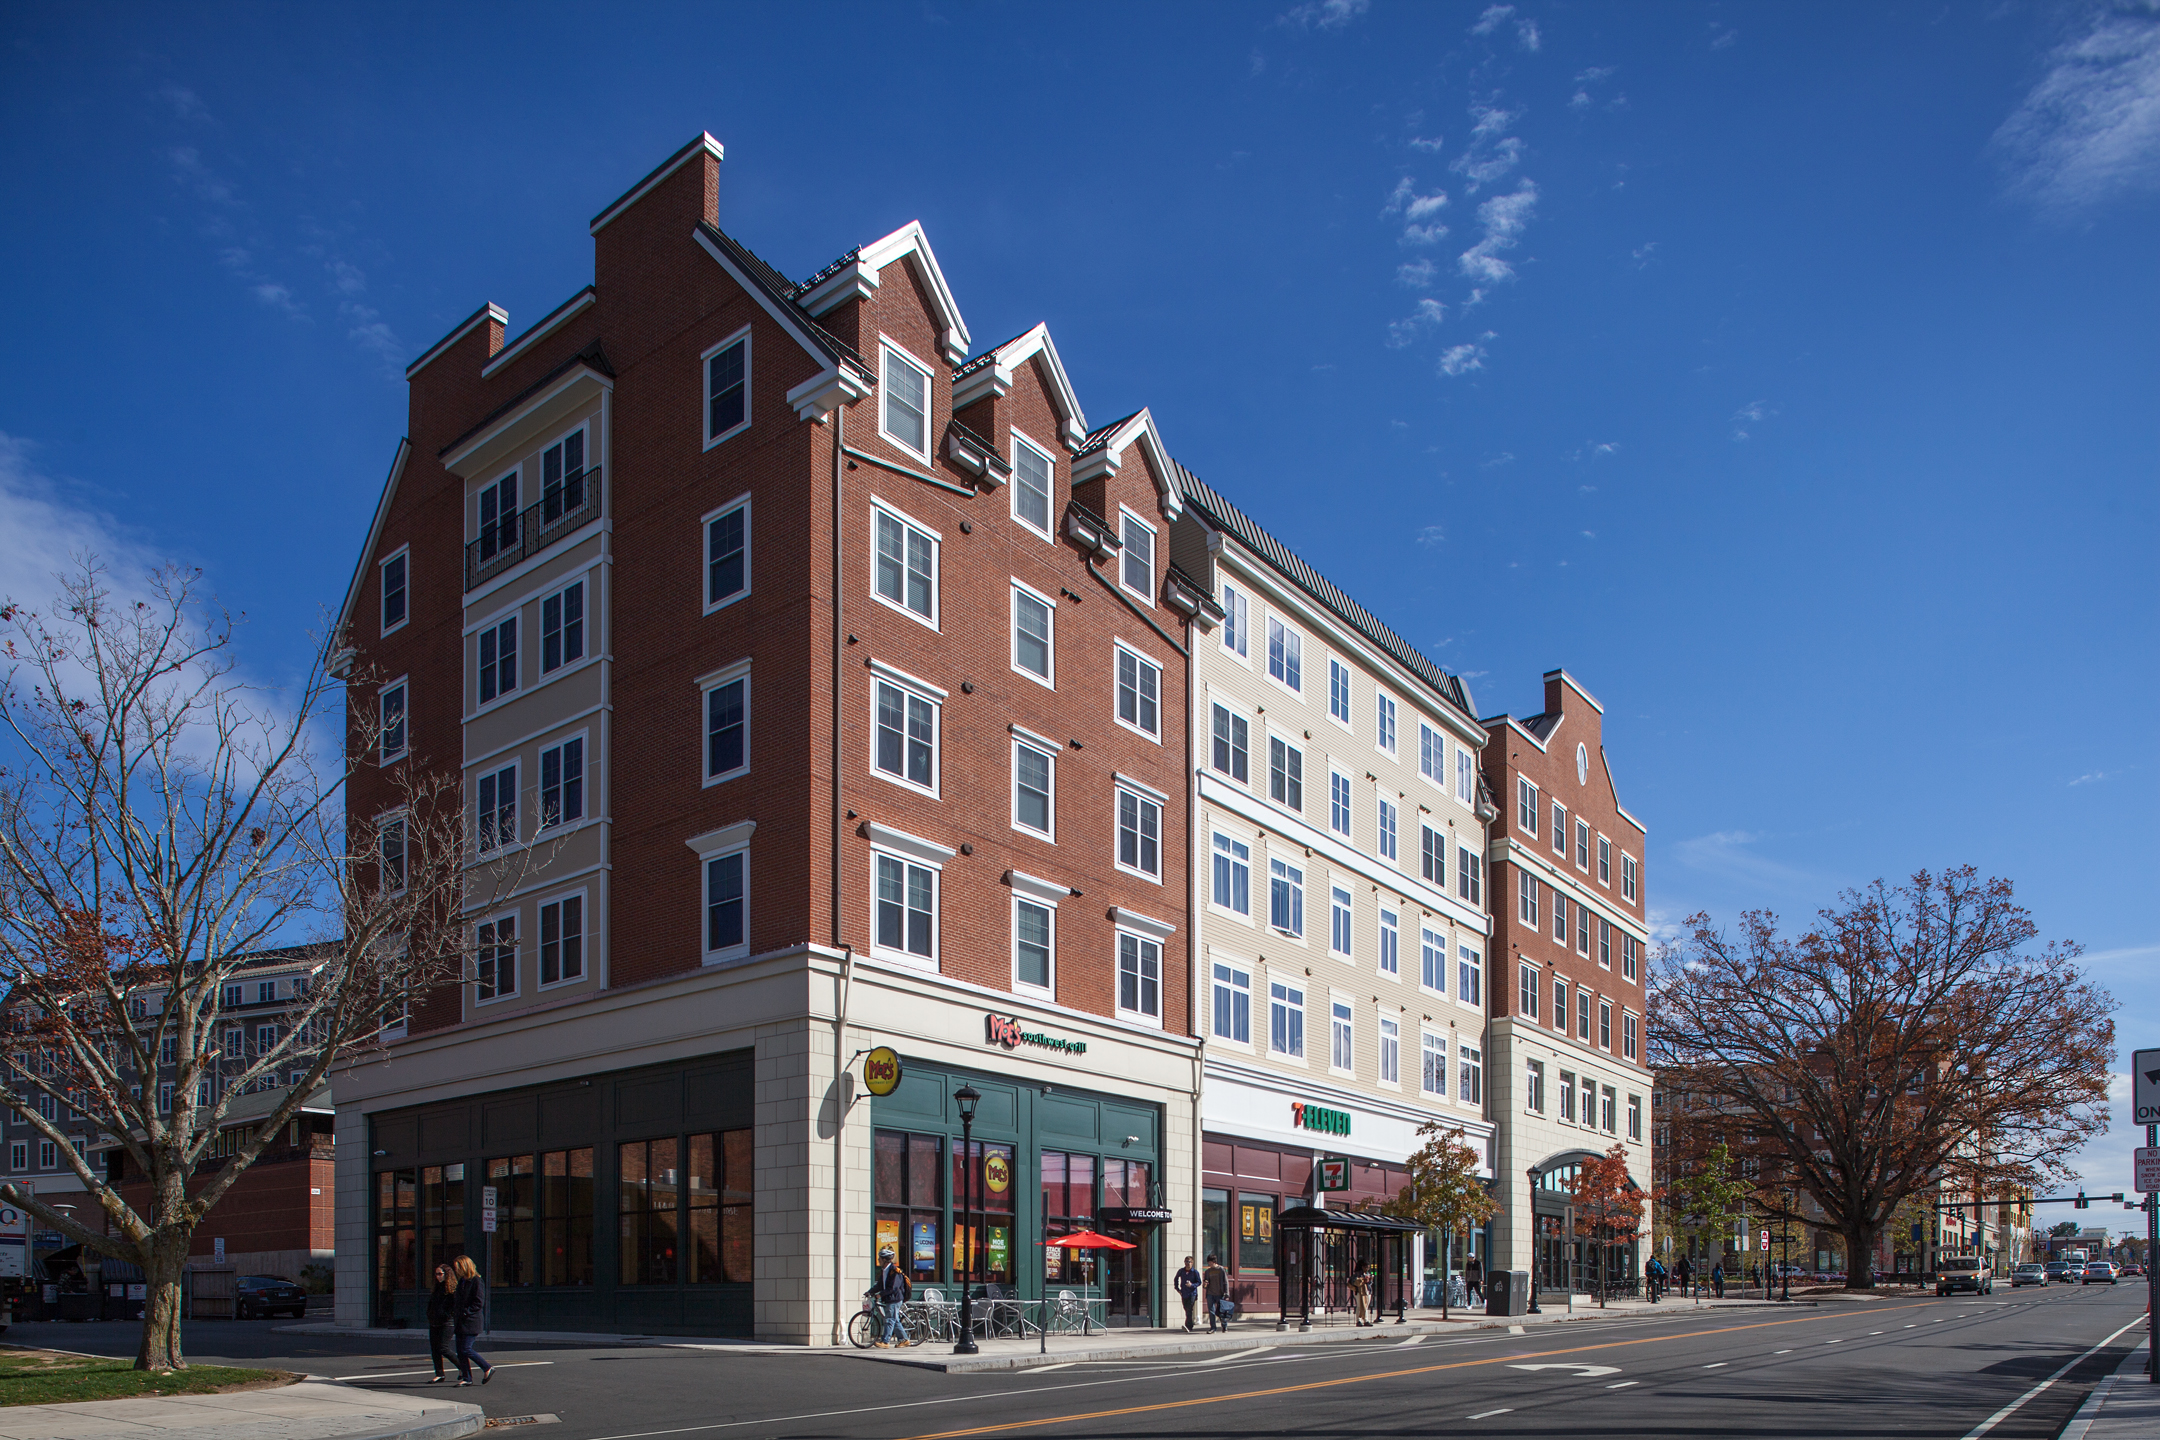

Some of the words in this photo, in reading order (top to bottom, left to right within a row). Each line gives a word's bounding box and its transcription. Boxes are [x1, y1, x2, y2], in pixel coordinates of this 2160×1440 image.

[1023, 1031, 1068, 1048] southwest
[1069, 1041, 1087, 1053] grill
[2138, 1106, 2160, 1119] ON
[2147, 1150, 2158, 1158] NO
[2137, 1158, 2160, 1166] PARKIN
[1325, 1164, 1341, 1188] 7
[1129, 1206, 1163, 1218] WELCOME
